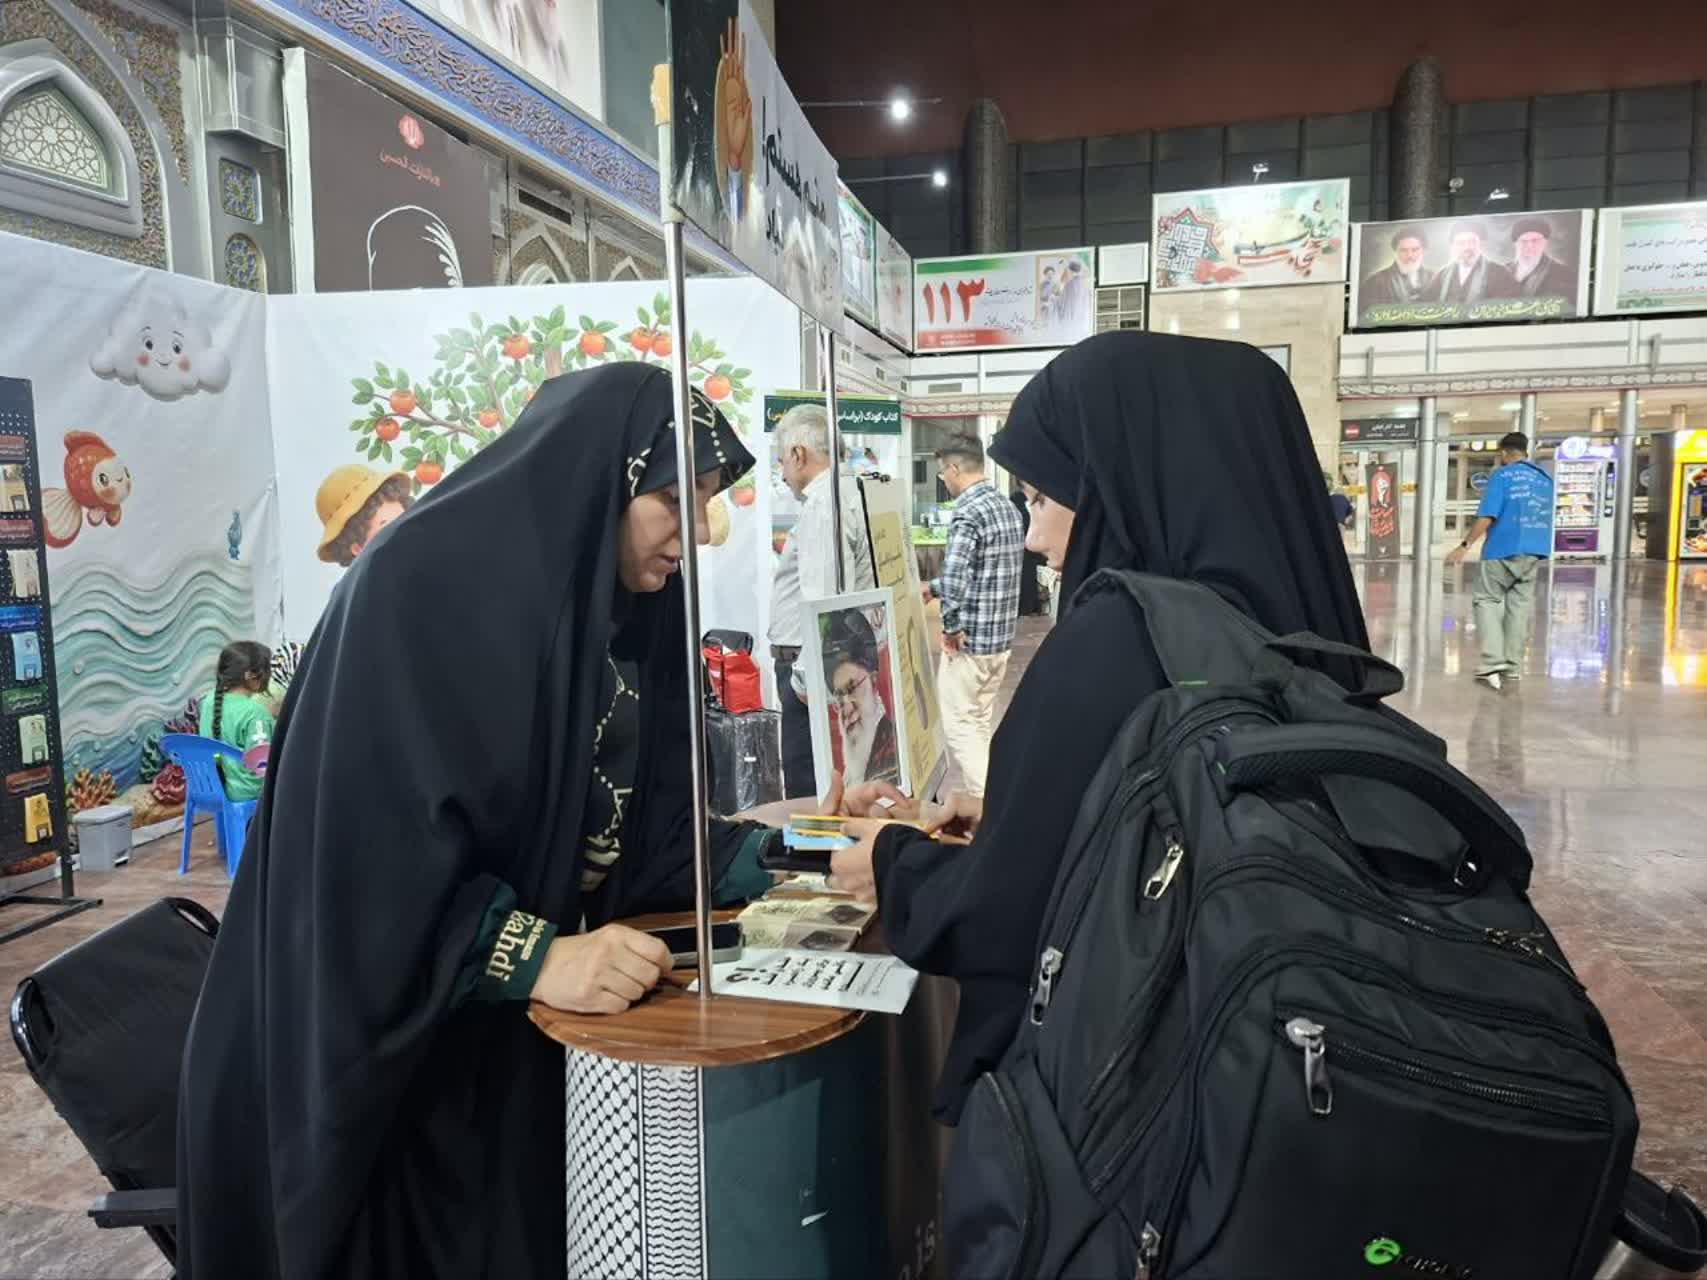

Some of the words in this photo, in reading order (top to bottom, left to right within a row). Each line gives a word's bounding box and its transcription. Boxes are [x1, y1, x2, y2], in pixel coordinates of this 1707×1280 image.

[923, 277, 985, 324] ۱۱۳
[863, 411, 882, 424] کودک
[879, 411, 899, 423] کتاب
